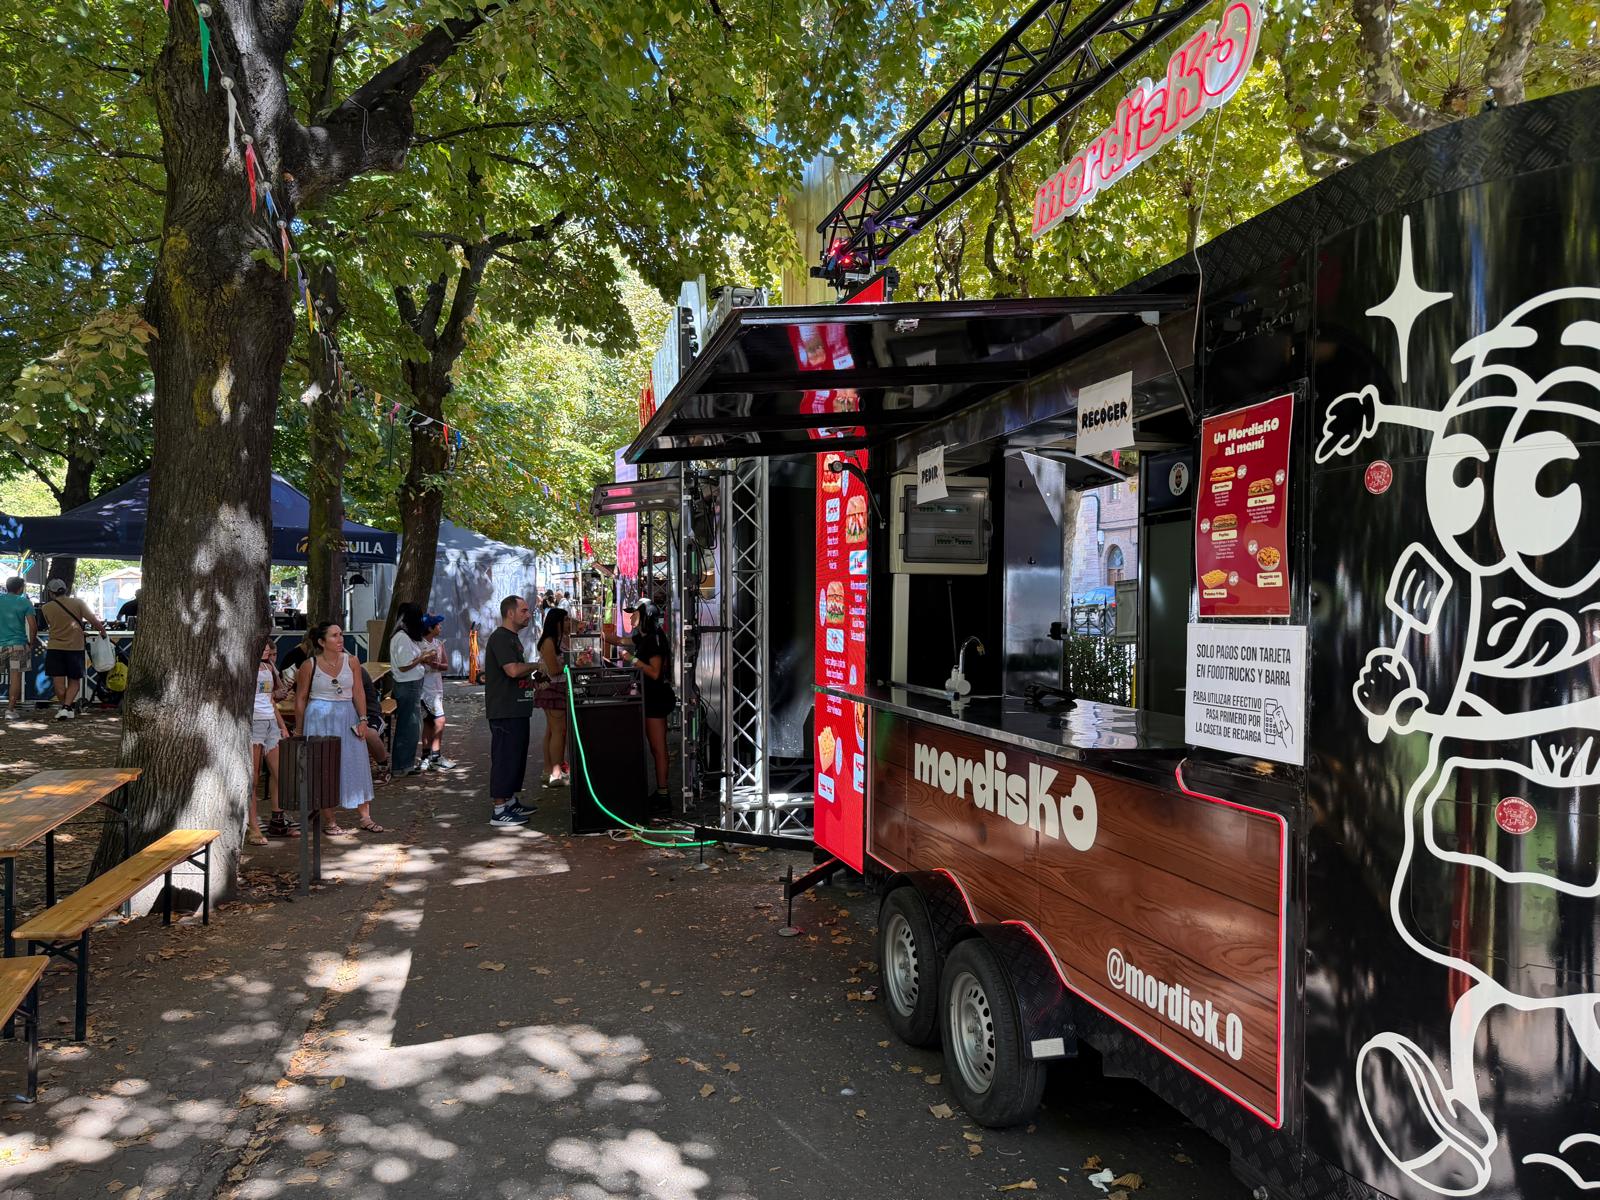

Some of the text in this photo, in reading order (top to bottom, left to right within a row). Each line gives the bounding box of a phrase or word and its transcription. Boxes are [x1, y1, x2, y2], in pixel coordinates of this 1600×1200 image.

[1081, 401, 1128, 430] RECOGER
[1213, 432, 1226, 445] Un
[1224, 436, 1265, 456] al menú
[921, 465, 939, 485] PEDIR
[1196, 643, 1291, 664] SOLO PAGOS CON TARJETA
[1196, 664, 1291, 686] EN FOODTRUCKS Y BARRA
[1193, 690, 1262, 709] PARA UTILIZAR EFECTIVO
[1205, 708, 1261, 728] PASA PRIMERO POR
[1195, 721, 1262, 743] LA CASETA DE RECARGA
